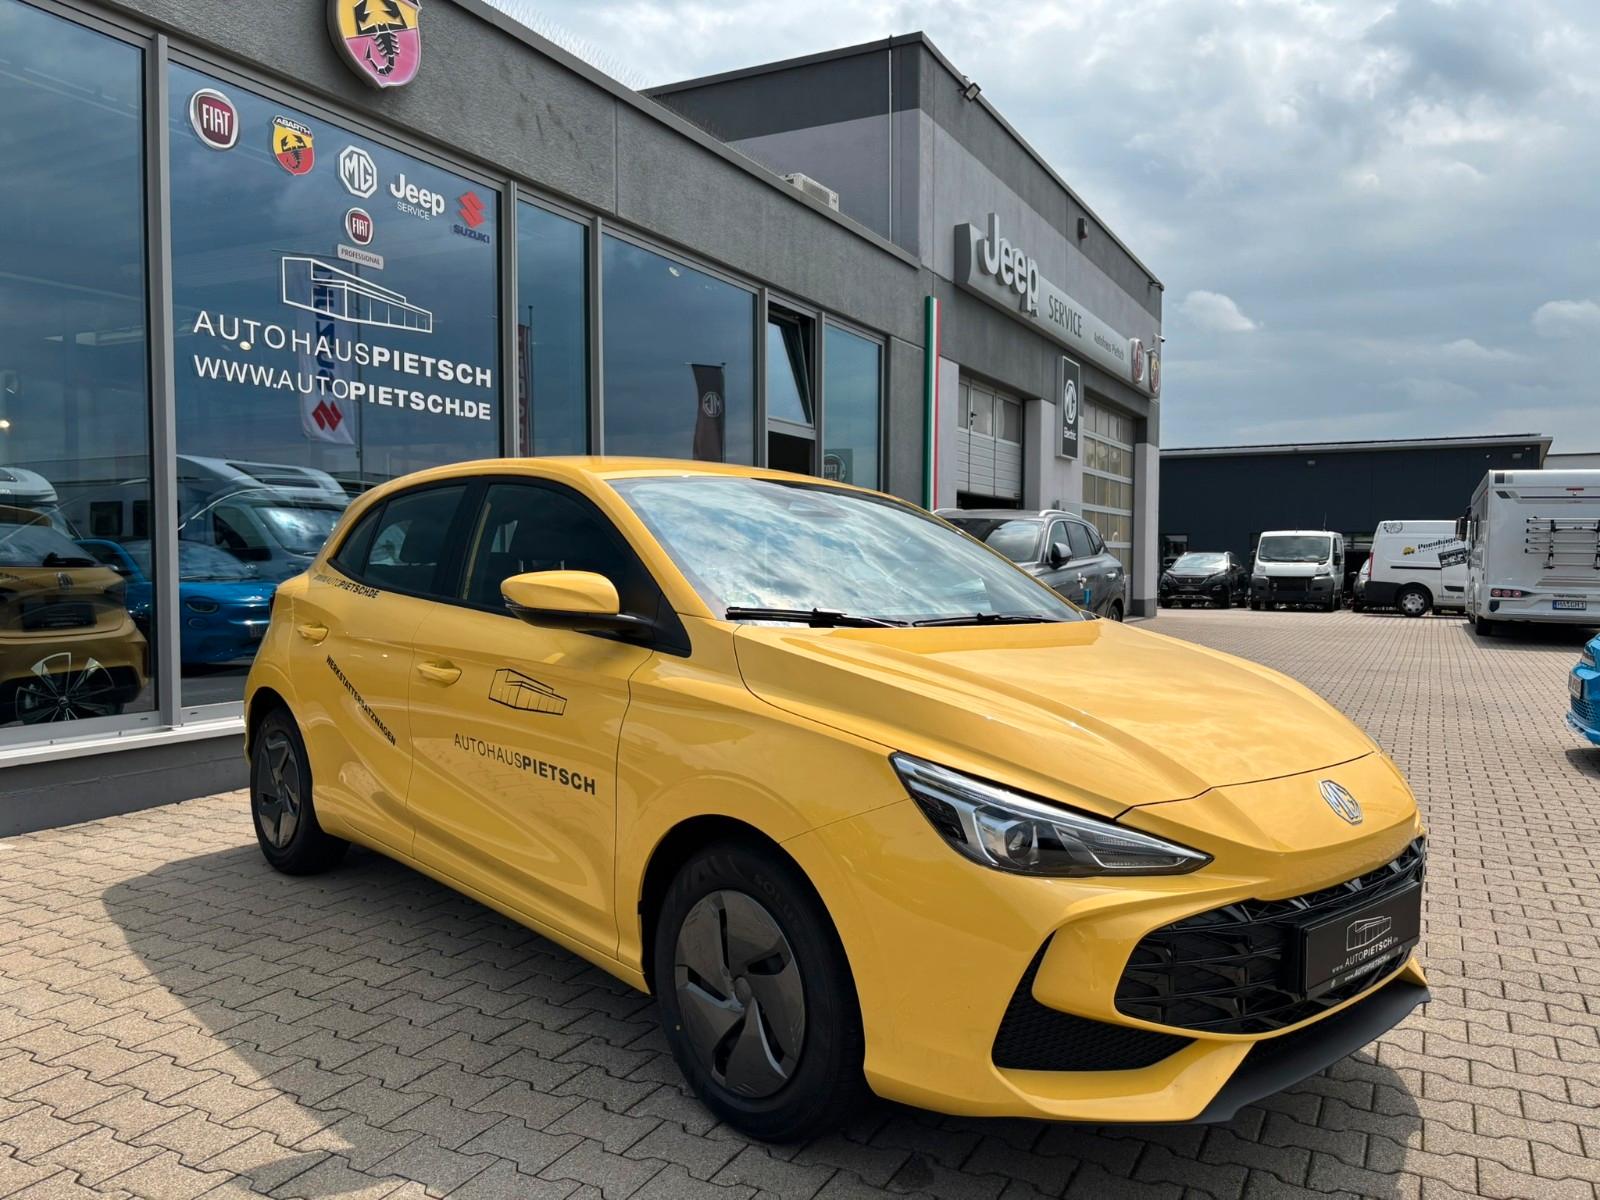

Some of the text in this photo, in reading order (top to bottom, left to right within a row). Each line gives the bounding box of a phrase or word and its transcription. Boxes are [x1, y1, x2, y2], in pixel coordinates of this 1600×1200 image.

[202, 103, 231, 136] FIAT
[275, 118, 312, 136] ABARTH
[343, 150, 375, 193] MG
[390, 173, 445, 217] Jeep
[397, 201, 430, 221] SERVICE
[352, 217, 369, 238] FIAT
[453, 224, 490, 244] SUZUKI
[341, 248, 380, 265] PROFESSIONAL
[979, 212, 1039, 315] Jeep
[1048, 295, 1082, 338] SERVICE
[193, 310, 492, 388] AUTOHAUSPIETSCH
[194, 354, 491, 421] WWW.AUTOPIETSCH.DE
[326, 654, 396, 747] WERKSTATTERSATZWAGEN
[454, 733, 596, 796] AUTOHAUSPIETSCH
[1320, 781, 1361, 823] MG
